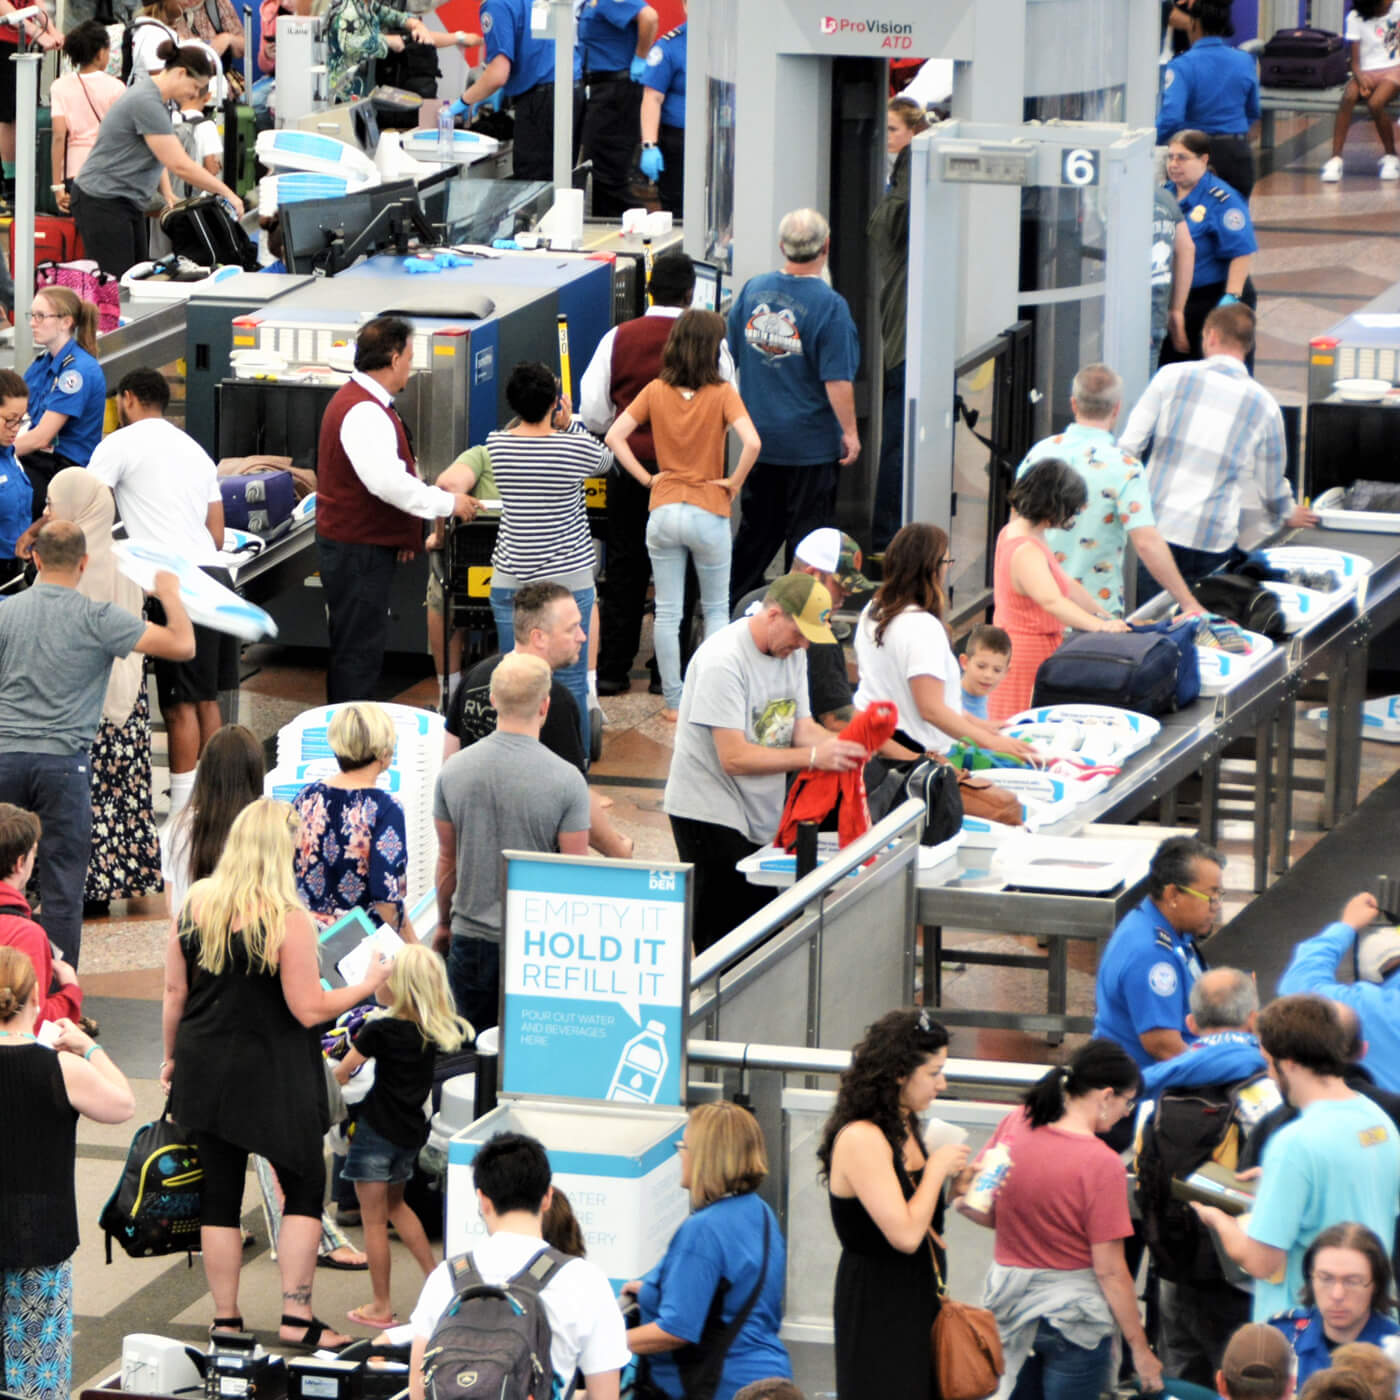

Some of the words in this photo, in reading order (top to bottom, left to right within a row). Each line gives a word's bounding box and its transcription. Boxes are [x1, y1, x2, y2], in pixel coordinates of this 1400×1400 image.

[840, 18, 912, 34] ProVision
[881, 35, 913, 49] ATD
[1066, 149, 1094, 185] 6
[649, 879, 676, 891] DEN
[524, 898, 631, 929] EMPTY
[641, 907, 668, 932] IT
[524, 930, 623, 962] HOLD
[634, 938, 666, 966] IT
[522, 963, 628, 995] REFILL
[638, 971, 665, 997] IT
[521, 1008, 552, 1021] POUR
[553, 1011, 577, 1022] OUT
[578, 1015, 616, 1025] WATER
[521, 1022, 544, 1033] AND
[544, 1023, 608, 1039] BEVERAGES
[520, 1033, 549, 1047] HERE
